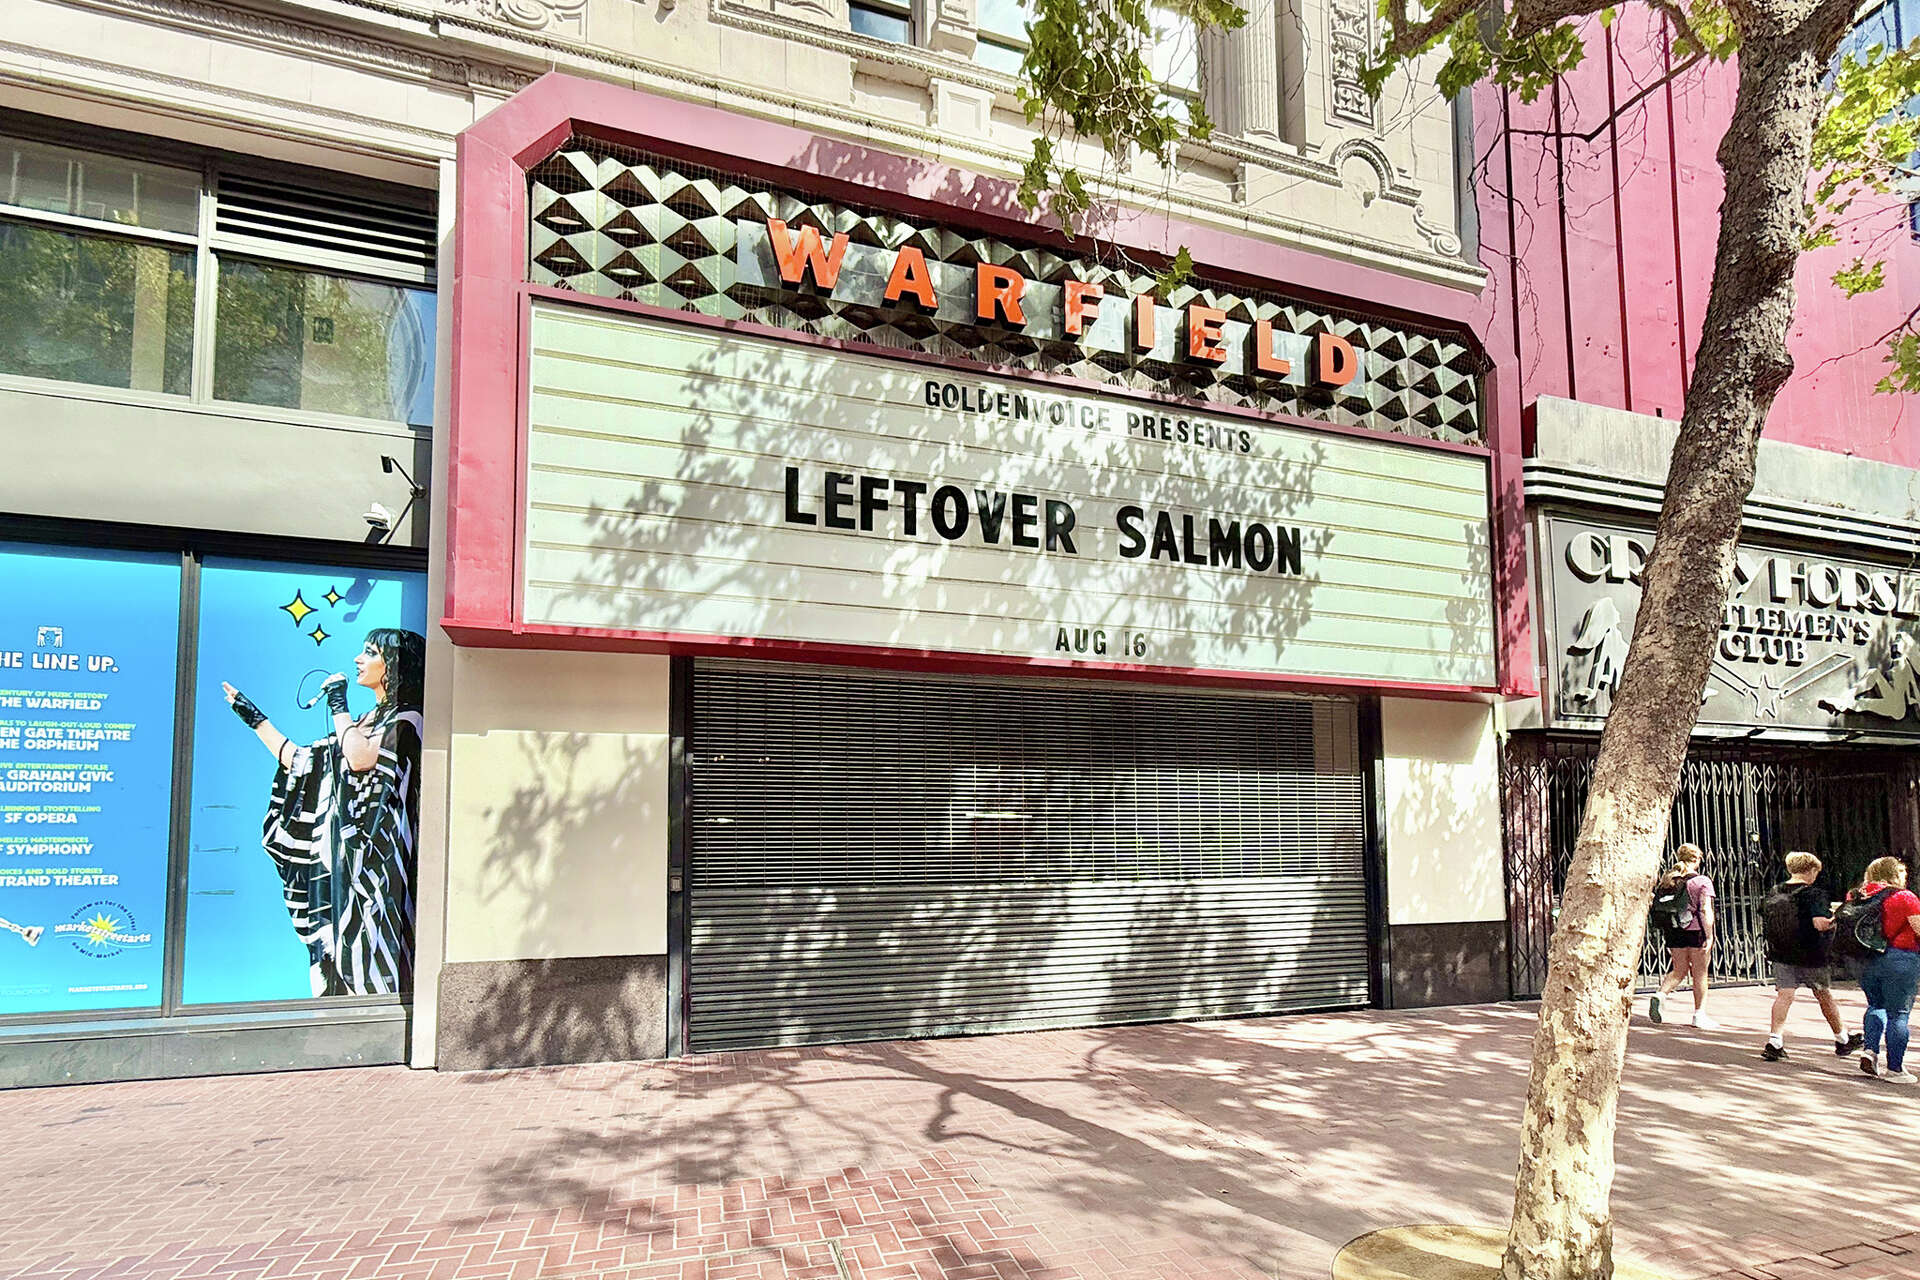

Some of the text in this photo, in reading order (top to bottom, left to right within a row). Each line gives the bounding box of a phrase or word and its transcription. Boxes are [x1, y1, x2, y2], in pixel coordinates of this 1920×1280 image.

[766, 218, 1359, 387] WARFIELD
[925, 380, 1251, 454] GOLDENVOICE PRESENTS
[785, 466, 1301, 576] LEFTOVER SALMON
[1566, 531, 1768, 598] CRY
[1722, 602, 1874, 643] TLEMEN'S
[1055, 627, 1146, 658] AUG 16
[1721, 633, 1808, 666] CLUB
[0, 652, 119, 672] HE LINE UP.
[0, 697, 102, 710] HE WARFIELD
[24, 728, 64, 738] GATE
[67, 729, 131, 740] THEATRE
[0, 739, 99, 751] HE ORPHEUM
[7, 770, 75, 780] GRAHAM
[79, 771, 114, 781] CIVIC
[5, 813, 77, 823] SF OPERA
[6, 844, 94, 855] SYMPHONY
[0, 875, 119, 887] TRAND THEATER
